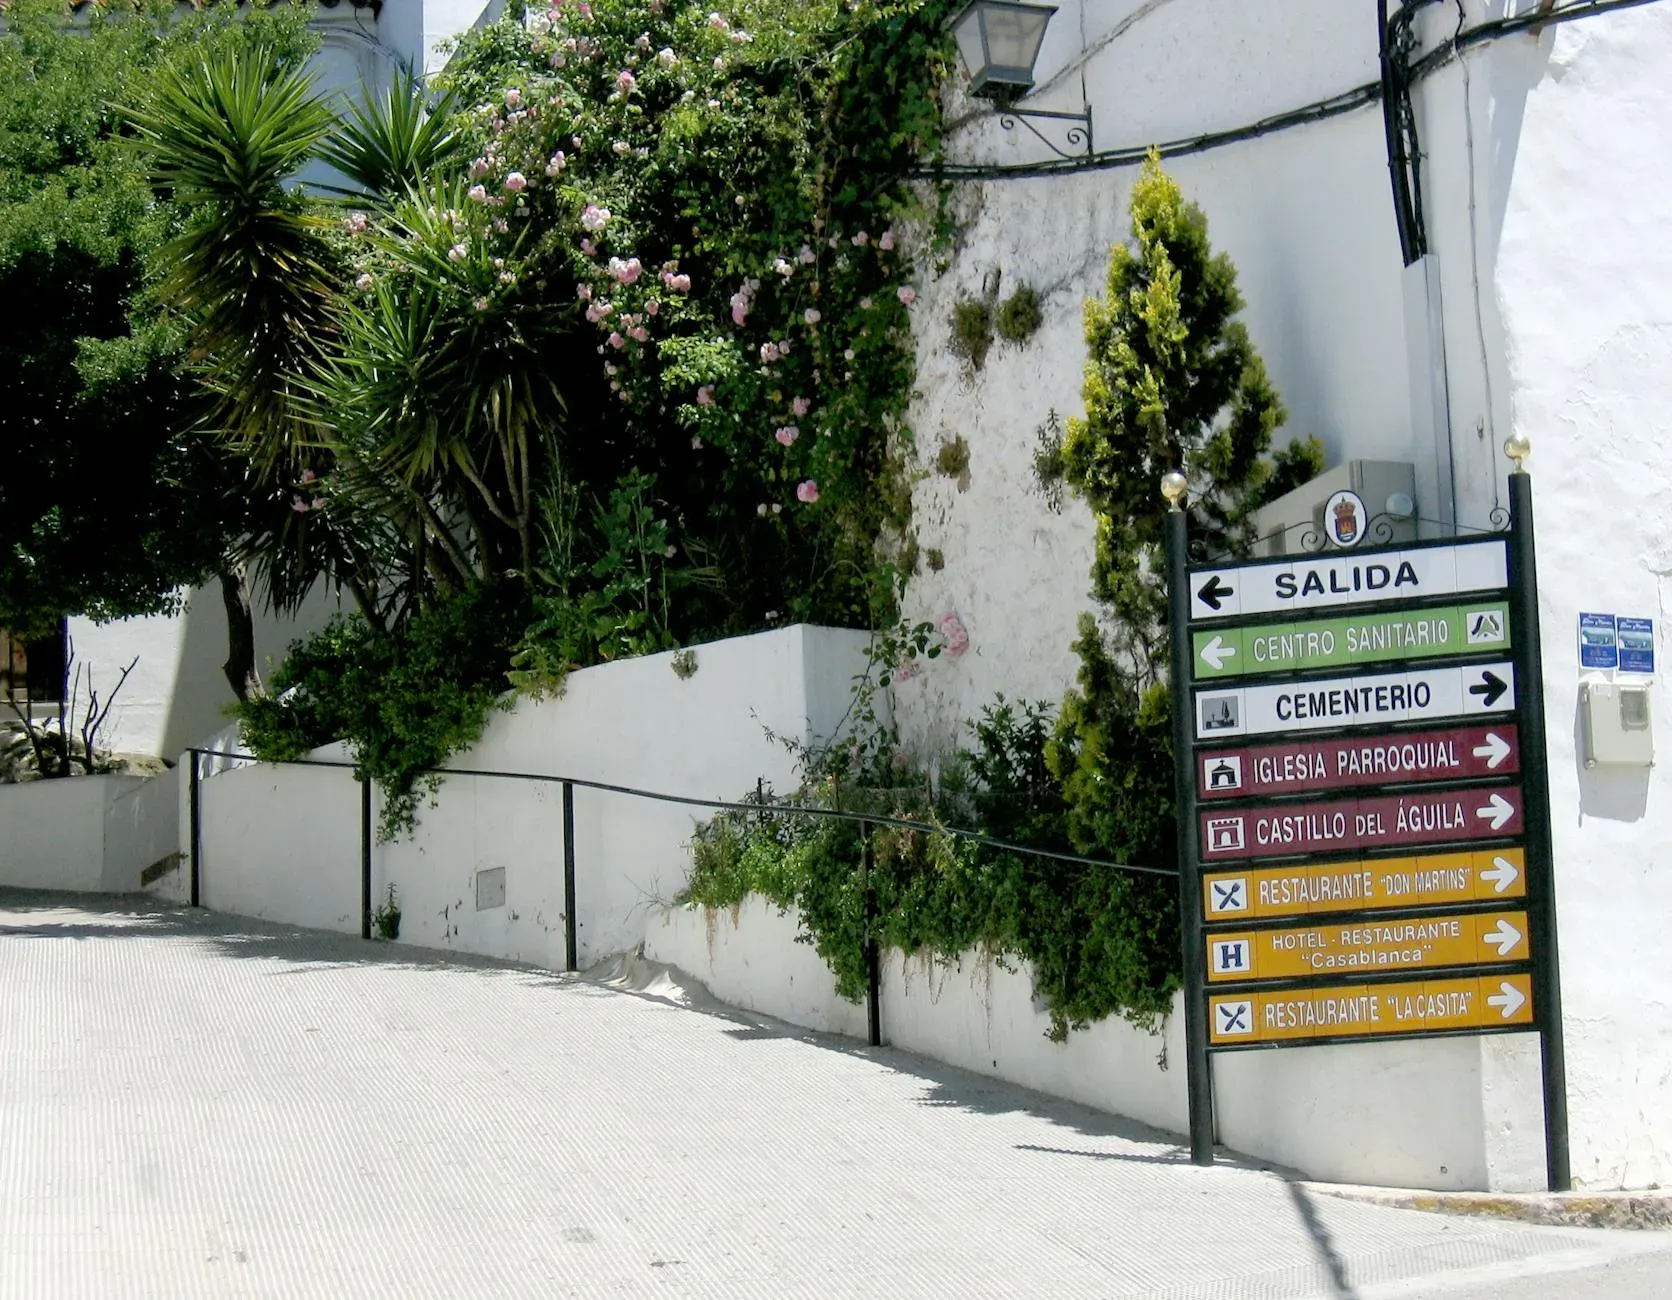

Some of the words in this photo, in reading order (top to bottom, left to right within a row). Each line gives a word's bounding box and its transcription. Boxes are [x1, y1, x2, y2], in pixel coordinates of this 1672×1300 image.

[1275, 561, 1419, 598] SALIDA
[1253, 631, 1335, 662] CENTRO
[1346, 619, 1449, 653] SANITARIO
[1276, 682, 1431, 721] CEMENTERIO
[1253, 753, 1326, 783] IGLESIA
[1338, 741, 1459, 776] PARROQUIAL
[1257, 813, 1346, 845] CASTILLO
[1356, 814, 1385, 836] DEL
[1396, 800, 1465, 832] ÁGUILA
[1260, 872, 1373, 905] RESTAURANTE
[1380, 873, 1410, 894] "DON
[1415, 868, 1471, 891] MARTINS"
[1272, 932, 1326, 950] HOTEL
[1341, 921, 1459, 945] RESTAURANTE
[1302, 945, 1432, 968] "Casablanca"
[1265, 996, 1379, 1028] RESTAURANTE
